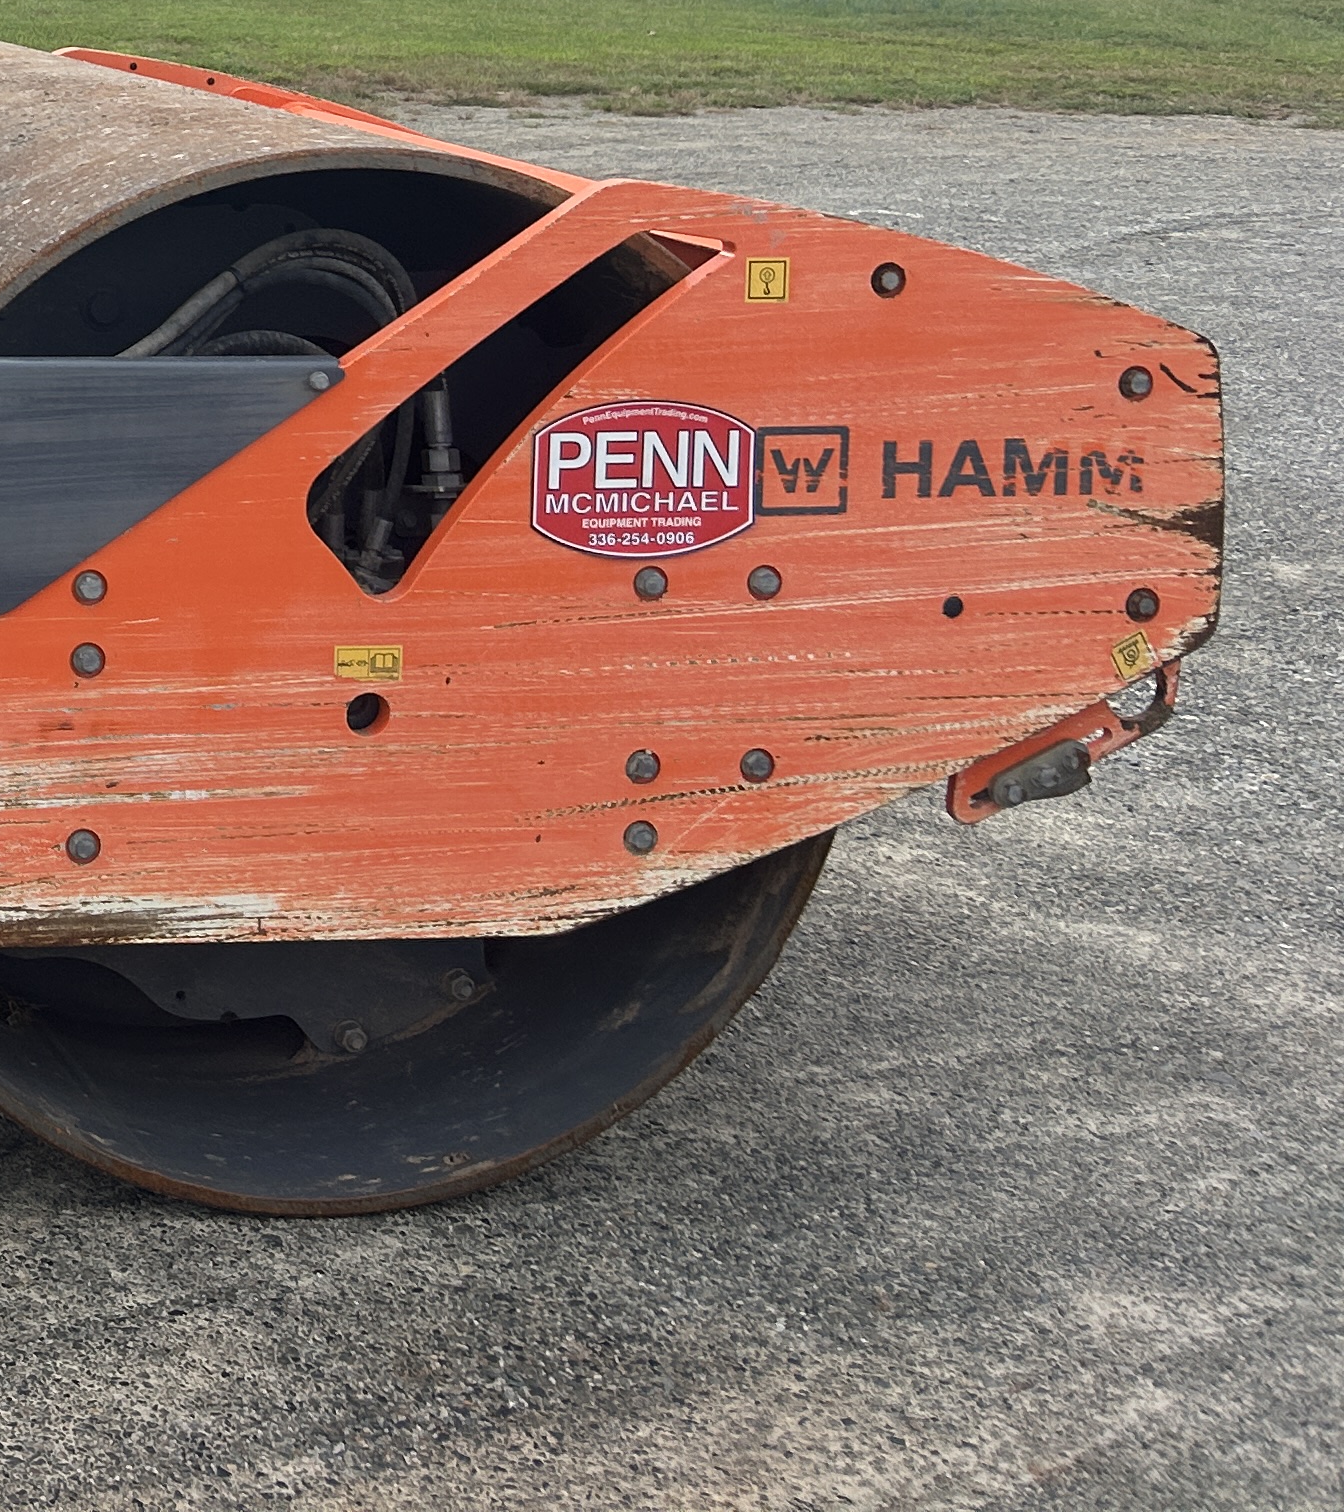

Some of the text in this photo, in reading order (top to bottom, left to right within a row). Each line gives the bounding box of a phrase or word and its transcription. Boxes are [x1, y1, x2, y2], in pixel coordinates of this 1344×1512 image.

[582, 407, 709, 425] PennEquipmentTrading.com
[547, 429, 742, 490] PENN
[881, 437, 1145, 499] HAMM
[545, 491, 740, 514] MCMICHAEL
[581, 516, 702, 529] EQUIPMENT TRADING
[588, 531, 695, 546] 336-254-0906
